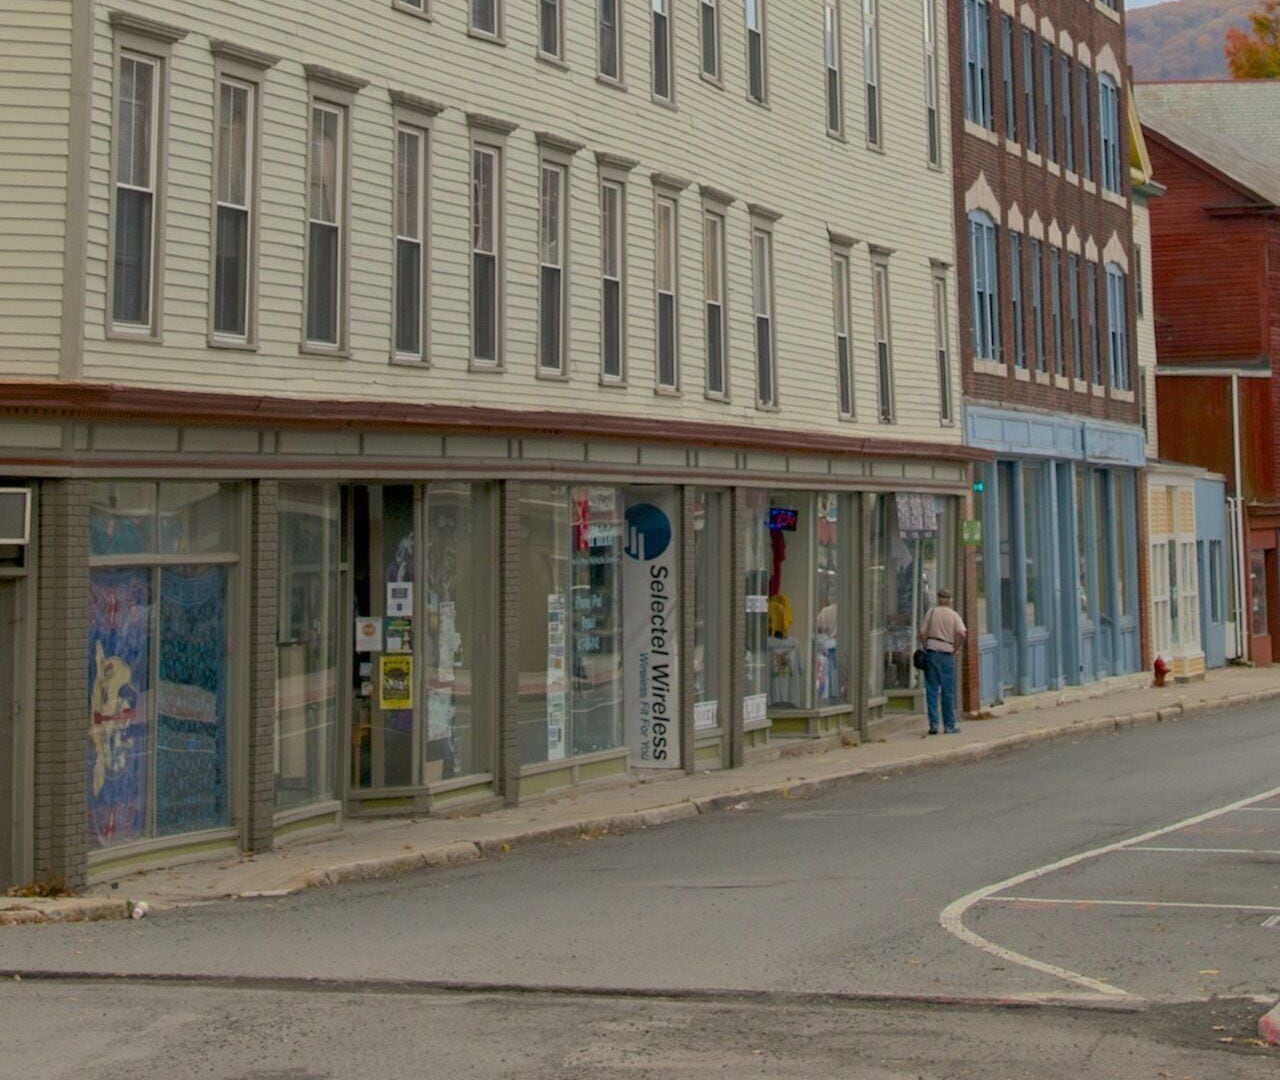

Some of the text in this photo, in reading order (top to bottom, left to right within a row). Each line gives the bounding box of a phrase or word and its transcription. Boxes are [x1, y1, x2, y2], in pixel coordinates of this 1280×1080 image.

[638, 652, 650, 761] Wireless Fit For You
[650, 563, 670, 761] Selectel Wireless
